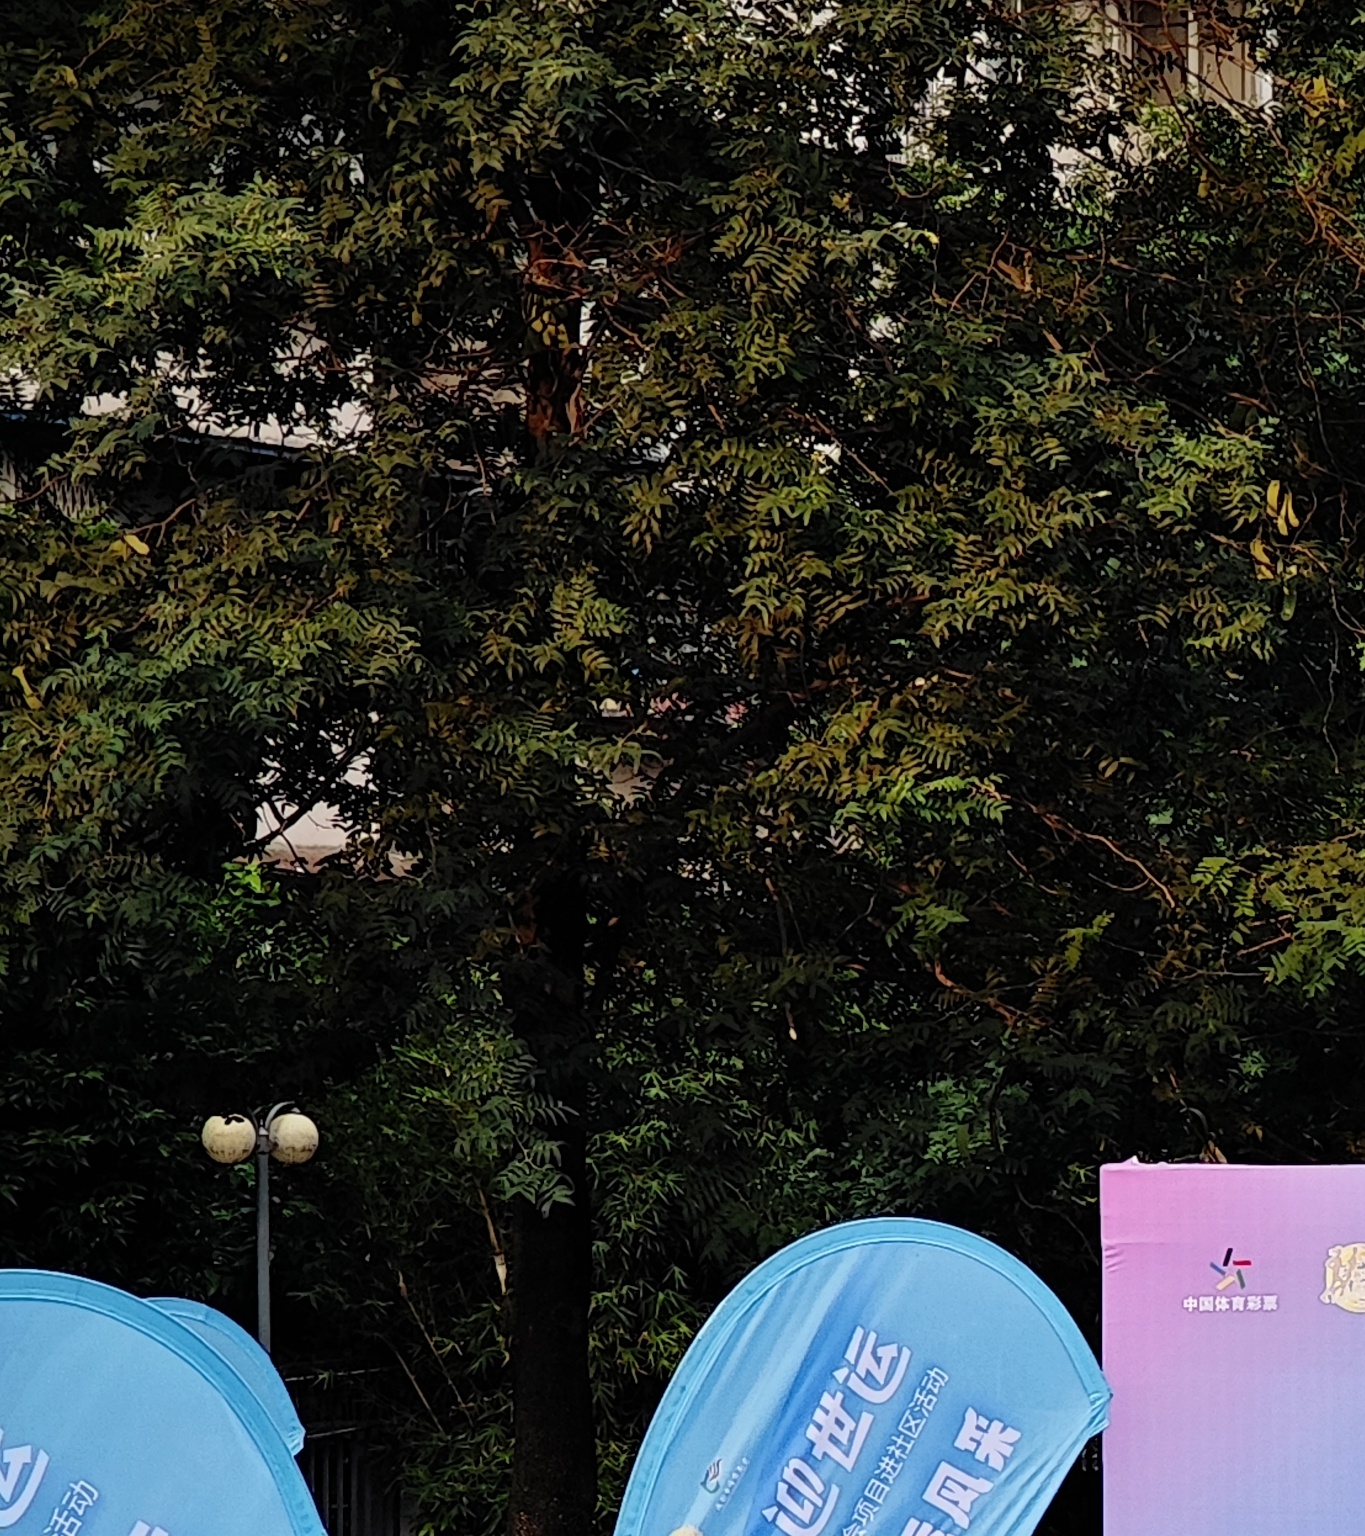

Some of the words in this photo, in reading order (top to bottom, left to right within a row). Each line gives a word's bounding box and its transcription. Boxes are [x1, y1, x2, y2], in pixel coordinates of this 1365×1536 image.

[1182, 1294, 1278, 1312] 中国体育彩票
